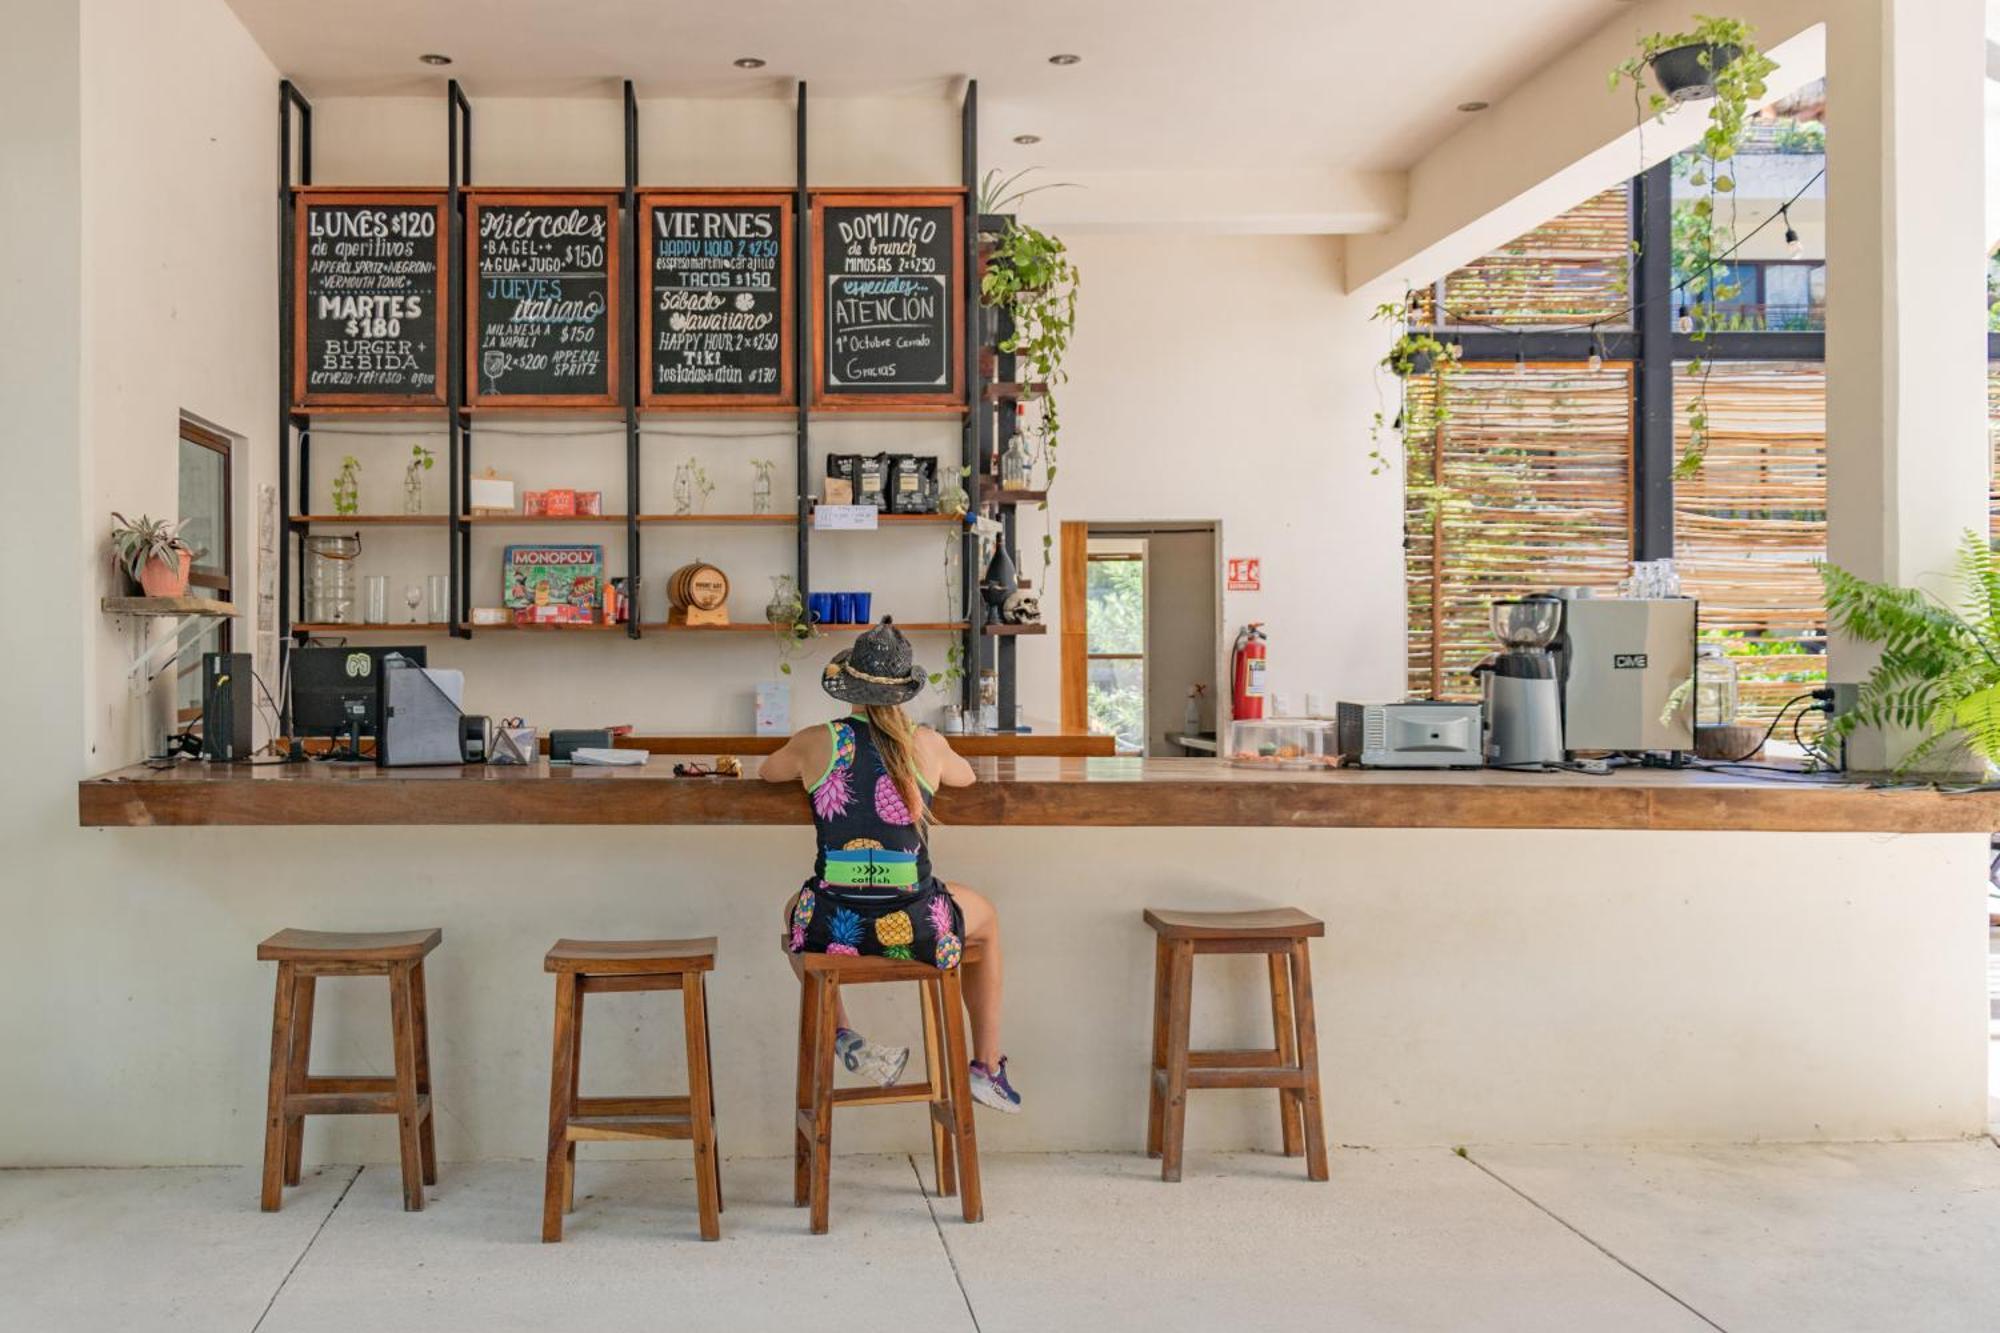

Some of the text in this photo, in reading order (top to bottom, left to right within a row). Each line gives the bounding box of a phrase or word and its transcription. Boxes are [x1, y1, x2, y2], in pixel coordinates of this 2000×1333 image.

[310, 210, 435, 237] LUNES $120
[480, 209, 605, 239] Miércoles
[654, 212, 773, 238] VIERNES
[838, 212, 937, 244] DOMINGO
[311, 238, 414, 261] de aperitivos
[488, 240, 538, 255] BAGEL
[660, 240, 701, 257] HAPPY
[704, 240, 733, 257] HOUR
[847, 238, 917, 259] de brunch
[484, 257, 561, 271] AGUA JUGO
[566, 245, 603, 268] $150
[388, 261, 432, 273] NEGRONI
[844, 258, 892, 273] MIMOSAS
[324, 276, 406, 288] VERMOUTH TONIC
[679, 272, 771, 287] TACOS $150
[488, 279, 562, 299] JUEVES
[318, 295, 422, 319] MARTES
[511, 291, 605, 323] italiano
[836, 292, 935, 324] ATENCIÓN
[345, 318, 401, 338] $180
[486, 324, 541, 336] MILANESA
[561, 326, 595, 343] $150
[325, 340, 412, 355] BURGER
[482, 336, 536, 348] LA NAPOLI
[659, 332, 703, 350] HAPPY
[704, 332, 734, 352] HOUR
[850, 335, 891, 352] Octubre
[323, 355, 420, 370] BEBIDA
[554, 363, 597, 376] SPRITZ
[847, 357, 897, 379] Gracias
[411, 372, 435, 387] agua
[515, 551, 593, 564] MONOPOLY
